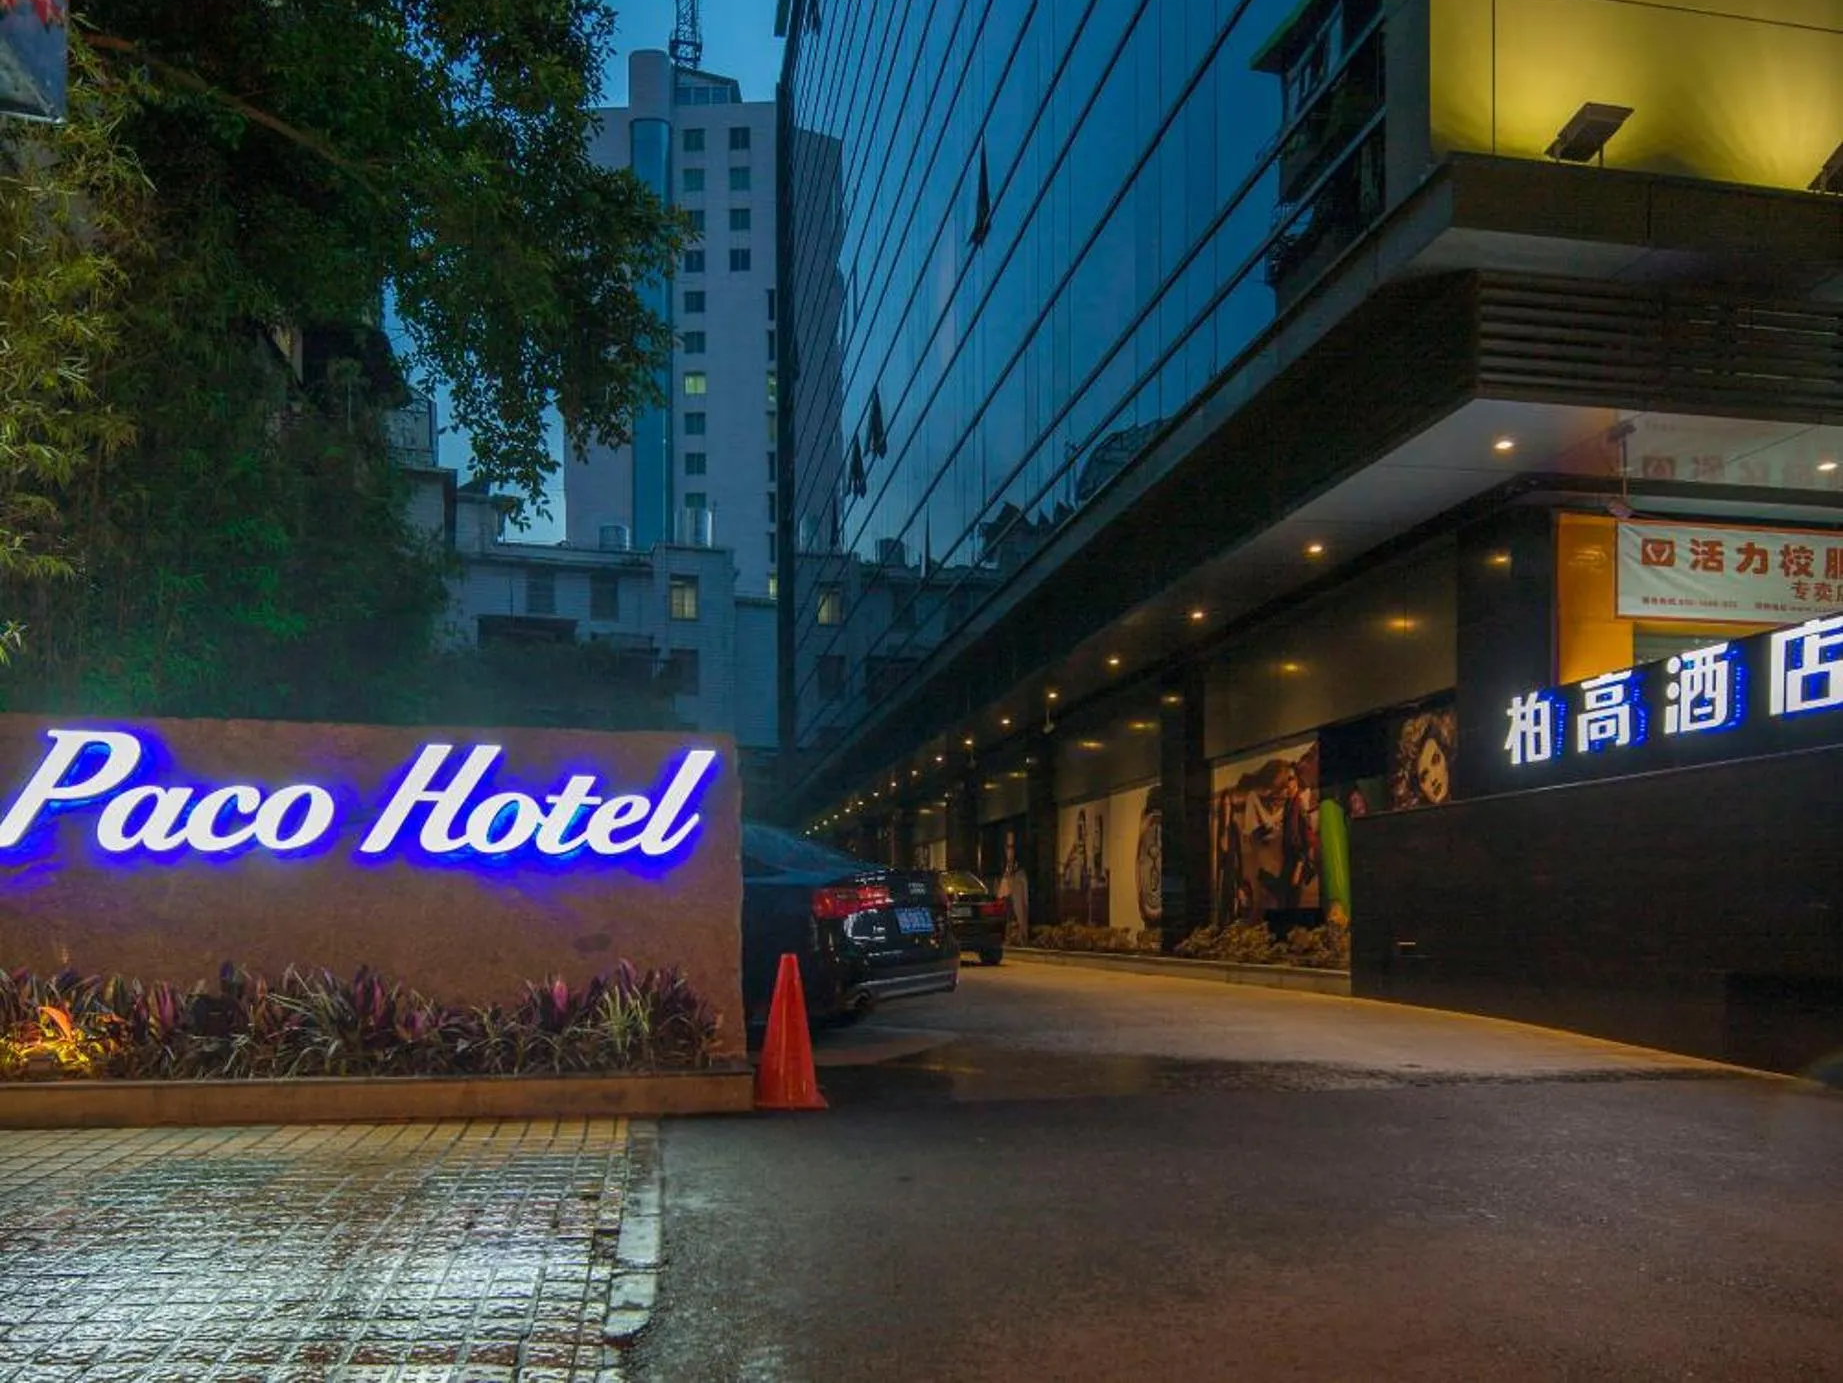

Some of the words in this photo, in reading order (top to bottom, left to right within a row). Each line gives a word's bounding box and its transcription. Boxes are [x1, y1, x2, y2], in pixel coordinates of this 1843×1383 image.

[1503, 615, 1843, 765] 柏高酒店
[0, 729, 335, 851] Paco
[359, 744, 716, 855] Hotel
